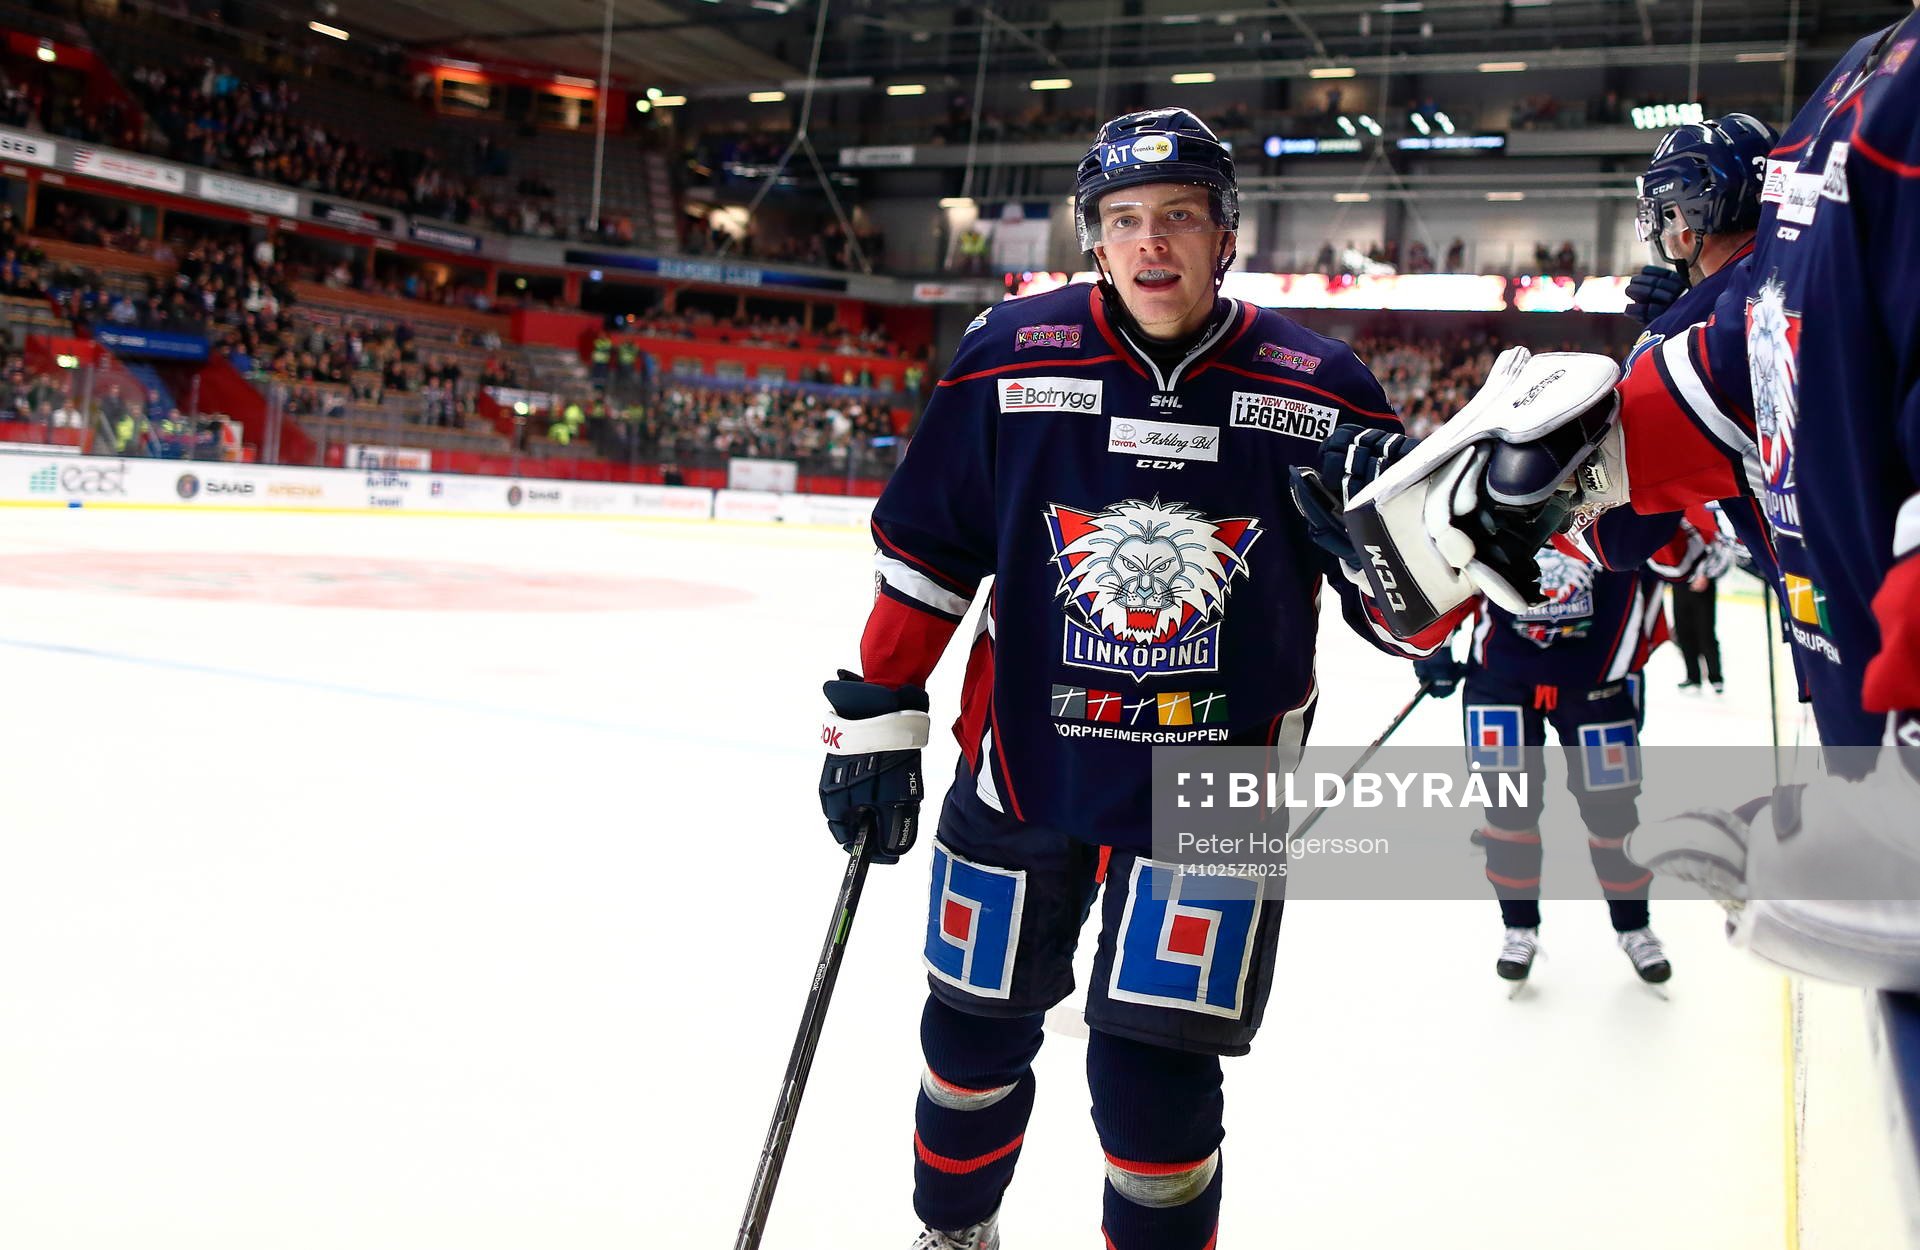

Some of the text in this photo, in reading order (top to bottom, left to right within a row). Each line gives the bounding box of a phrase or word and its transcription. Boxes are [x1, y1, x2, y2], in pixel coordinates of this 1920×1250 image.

[1105, 145, 1131, 167] ÄT
[1652, 182, 1675, 195] CCM
[1018, 330, 1081, 344] KARAMELLO
[1258, 346, 1317, 369] KARAMELLO
[1025, 387, 1097, 409] Botrygg
[1150, 394, 1183, 409] SHL
[1260, 396, 1308, 413] NEW YORK
[1234, 403, 1330, 440] LEGENDS
[1111, 439, 1137, 448] TOYOTA
[1139, 431, 1217, 453] Ashling Bil
[1136, 459, 1185, 470] CCM
[1363, 544, 1407, 614] CCM
[1074, 631, 1210, 668] LINKÖPING
[908, 772, 918, 796] 30K
[899, 817, 911, 846] Reebok
[811, 963, 826, 992] Reebok
